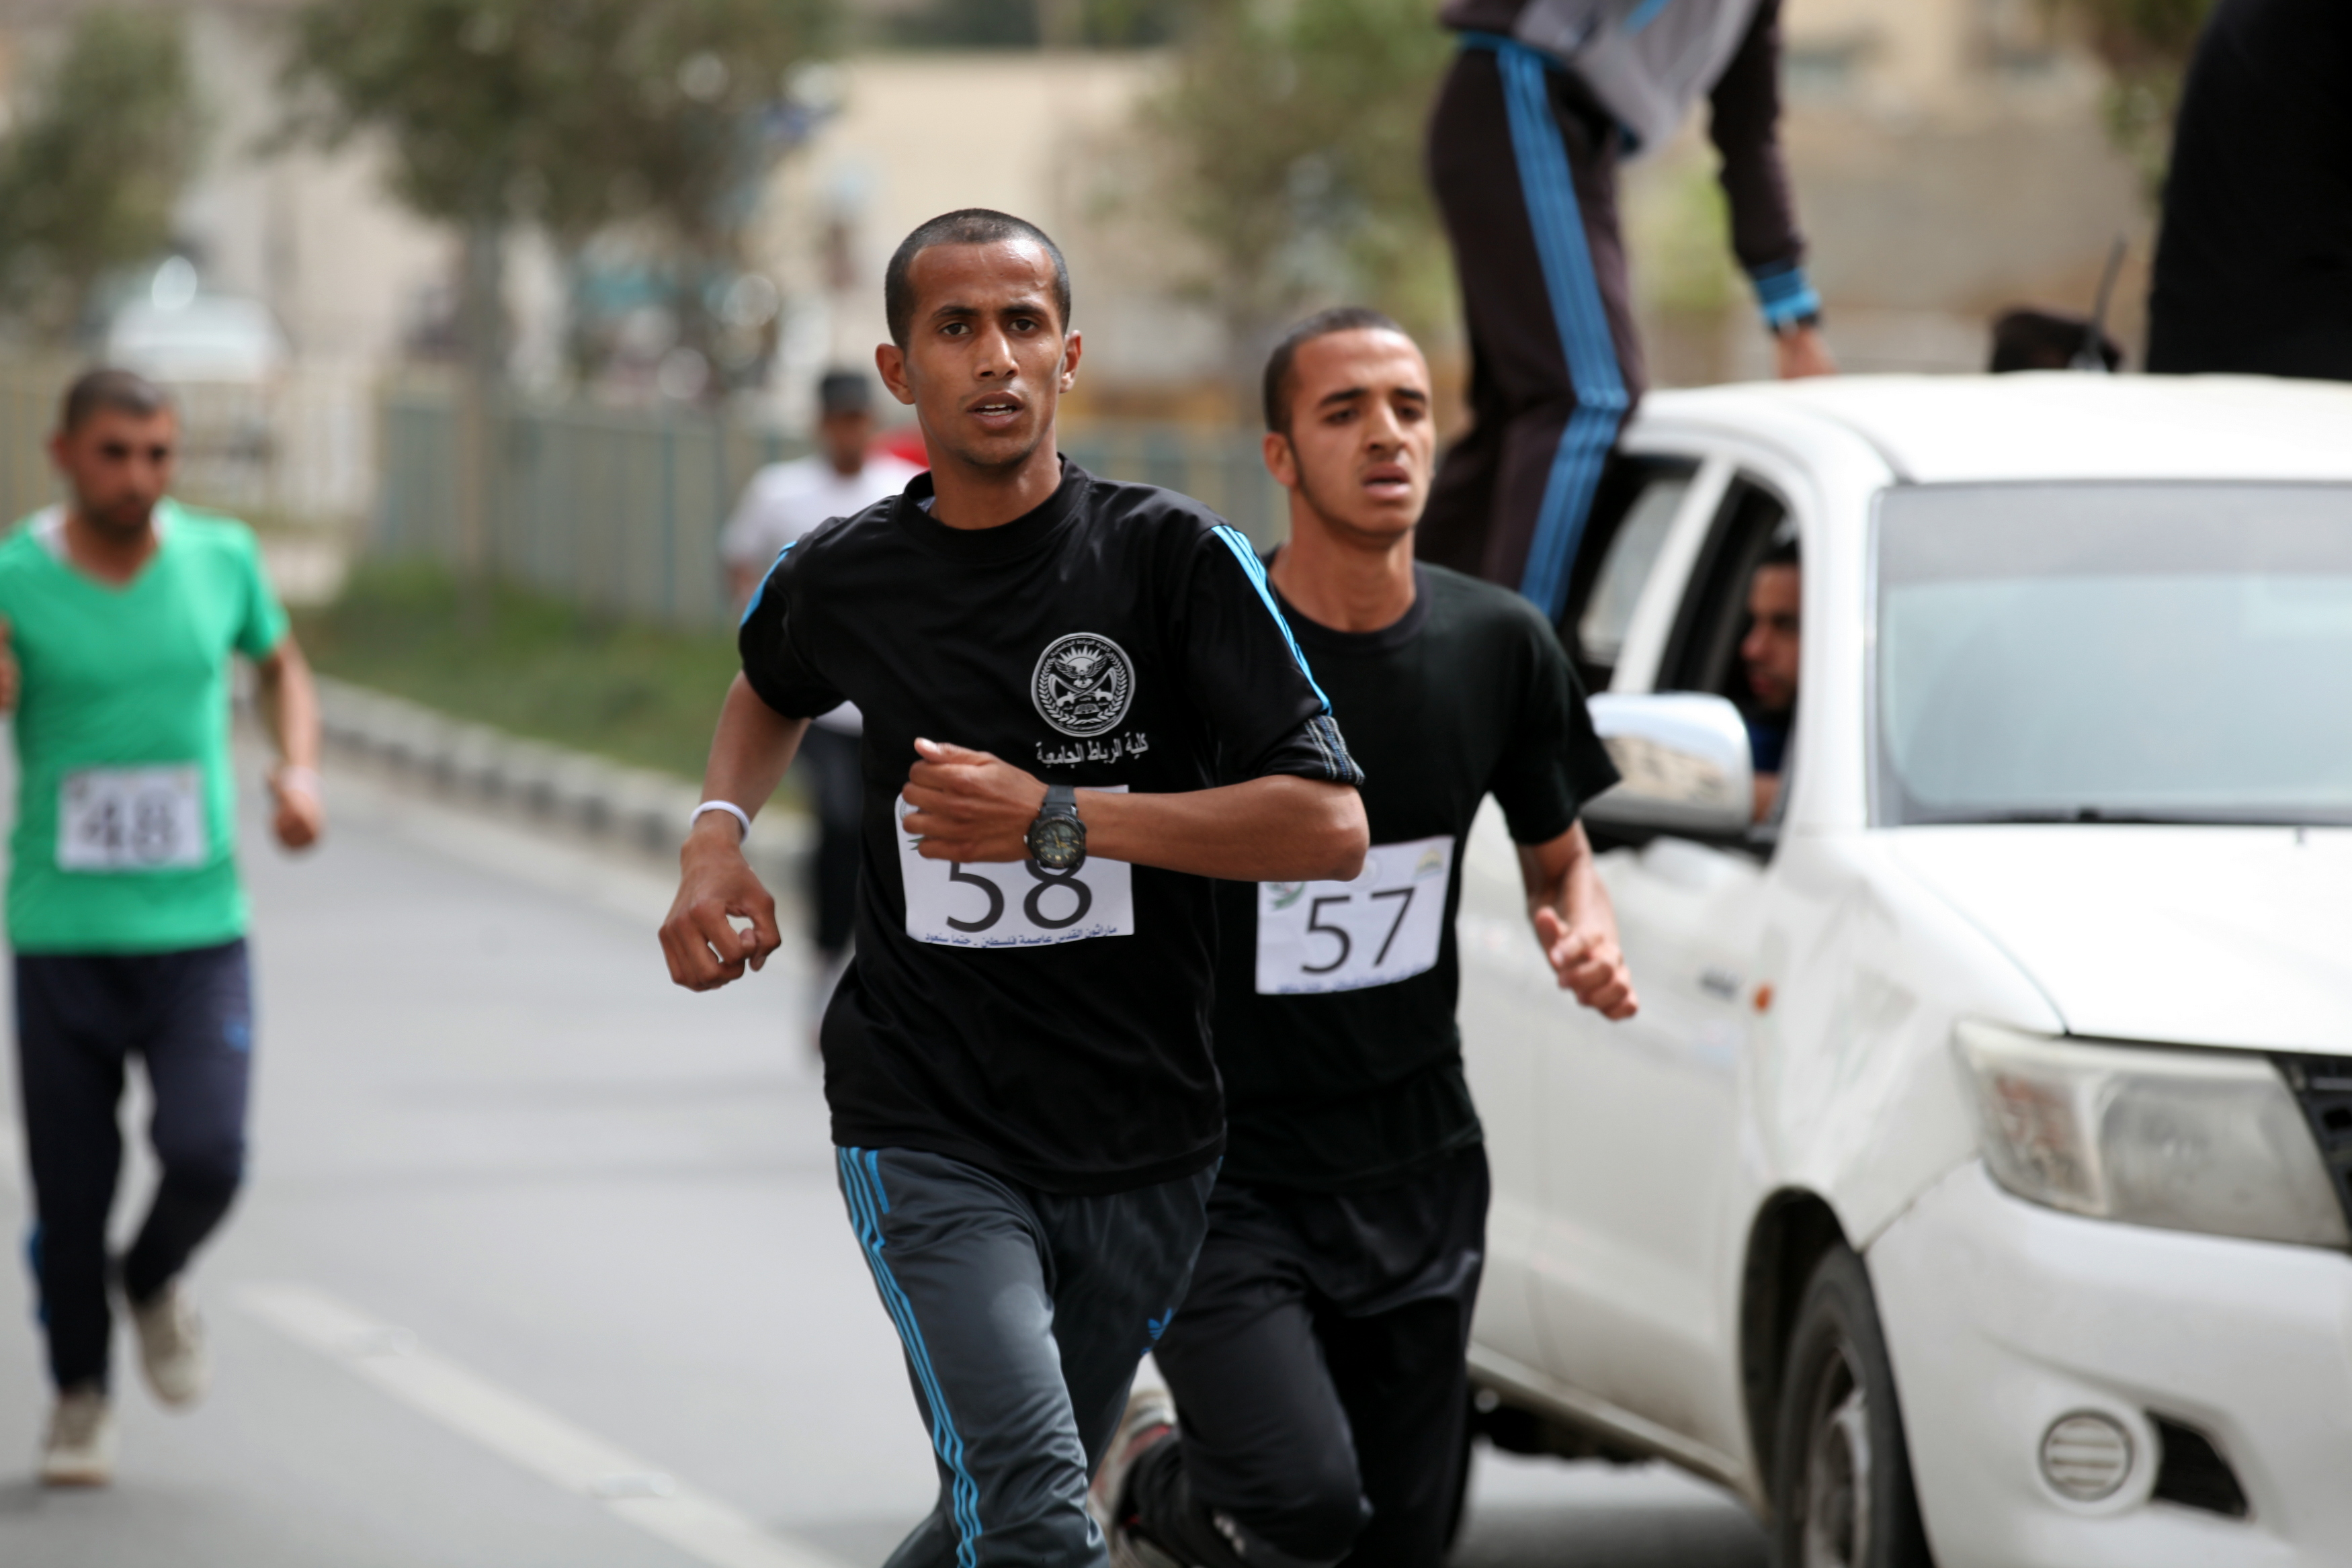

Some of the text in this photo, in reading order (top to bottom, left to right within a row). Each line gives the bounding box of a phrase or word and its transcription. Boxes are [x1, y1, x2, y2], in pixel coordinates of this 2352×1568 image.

[1036, 731, 1149, 769] كلية الرباط الجامعية
[80, 790, 179, 865] 48
[946, 857, 1092, 933] 58
[980, 935, 1017, 948] فلسطين
[1019, 934, 1052, 945] عاصمة
[1055, 928, 1083, 945] القدس
[1300, 886, 1417, 975] 57
